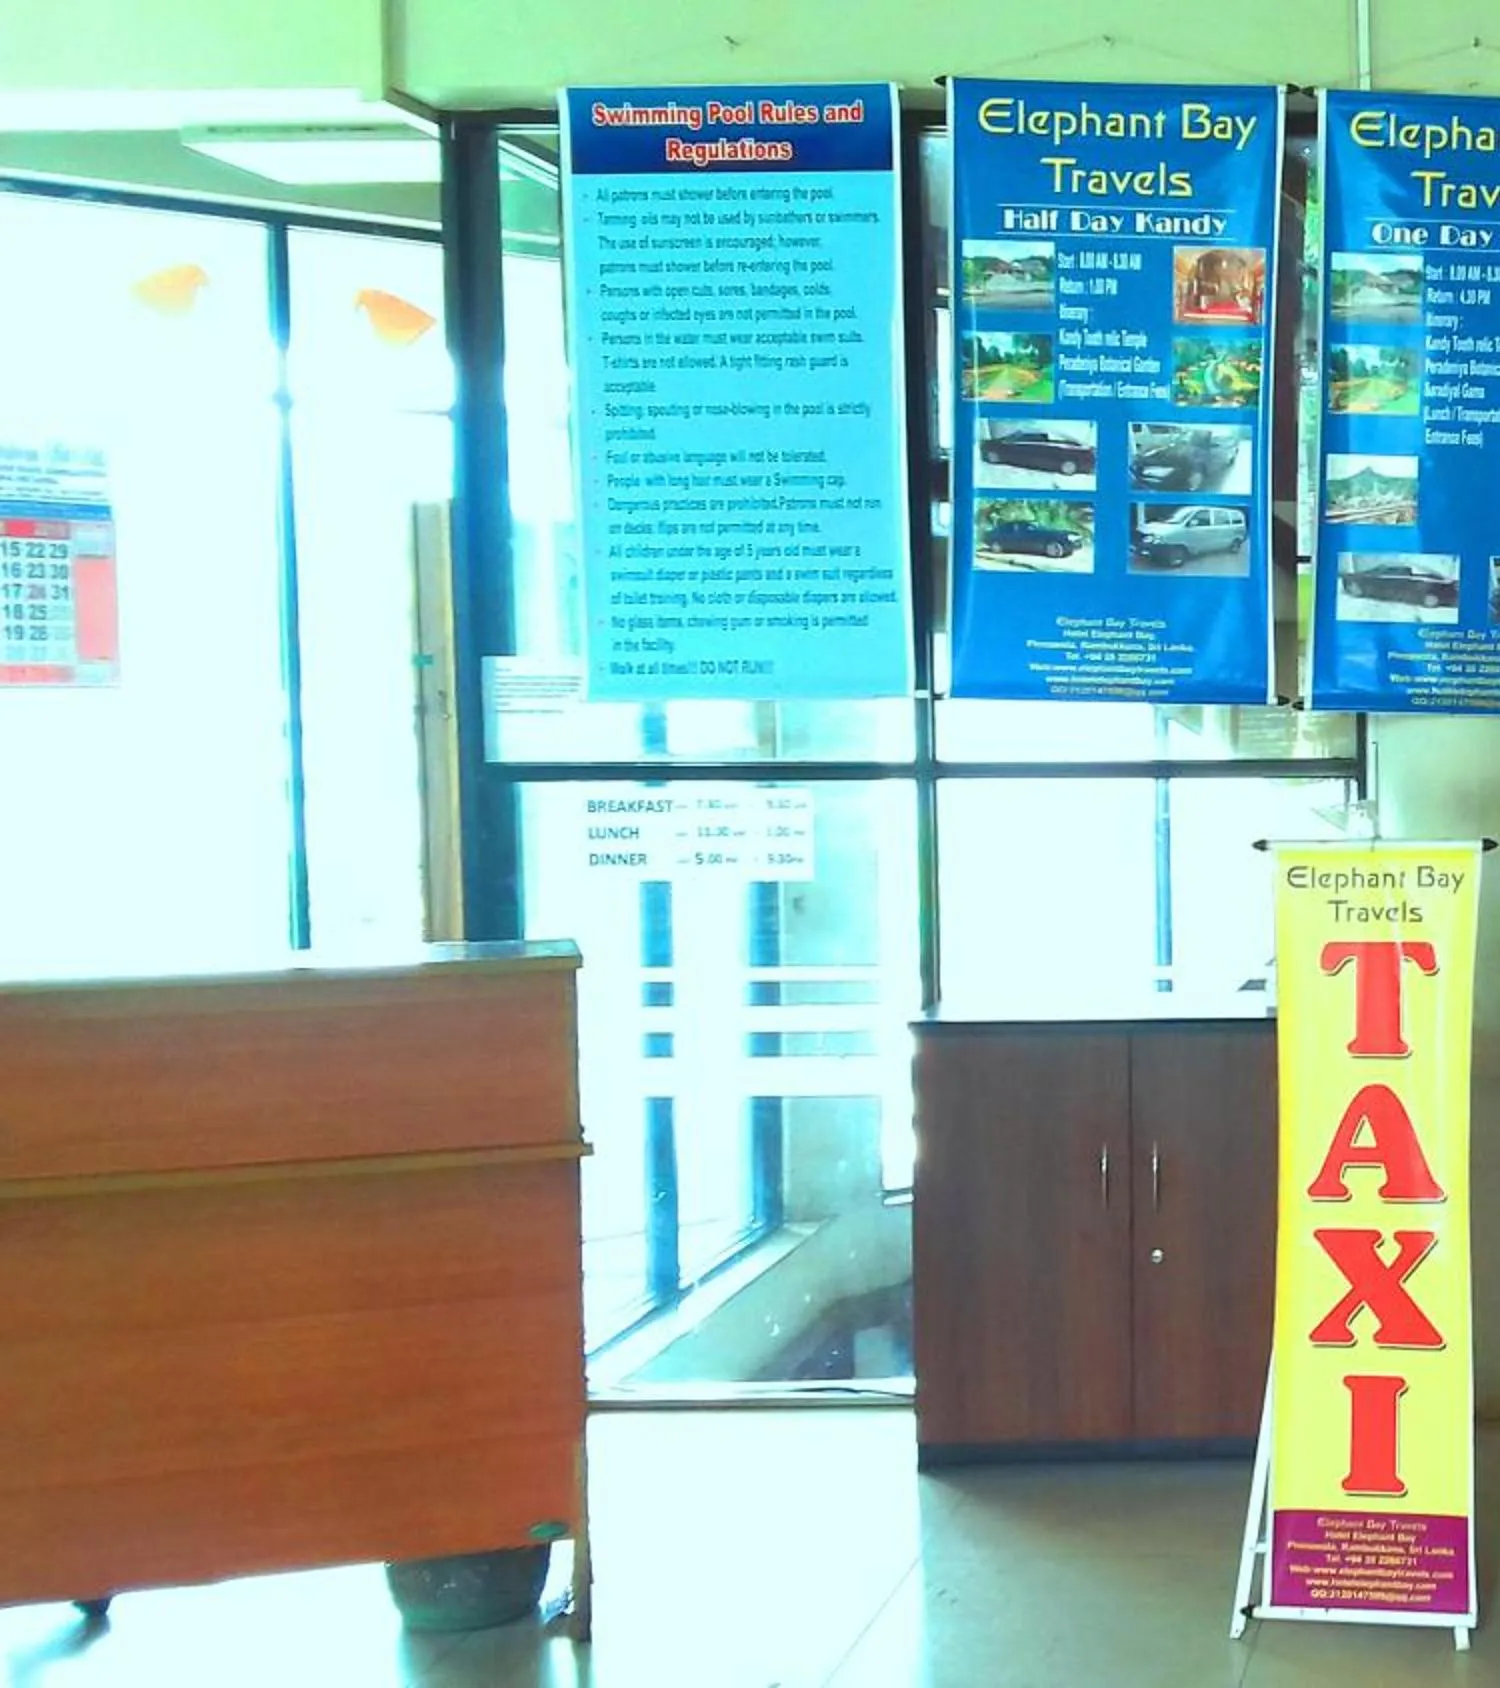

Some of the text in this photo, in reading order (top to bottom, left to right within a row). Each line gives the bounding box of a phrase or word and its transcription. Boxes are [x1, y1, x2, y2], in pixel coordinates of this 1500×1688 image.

[592, 99, 864, 130] Swimming Pool Rules and
[978, 97, 1257, 150] Elephant Bay
[665, 137, 793, 166] Regulations
[1040, 157, 1194, 197] Travels
[1003, 209, 1228, 236] Half Day Kandy
[1371, 223, 1429, 245] One
[1439, 225, 1494, 248] Day
[26, 542, 45, 559] 22
[50, 543, 69, 560] 29
[1, 562, 22, 579] 16
[27, 563, 46, 580] 23
[2, 584, 23, 600] 17
[51, 584, 70, 601] 31
[3, 604, 48, 621] 18 25
[4, 624, 25, 641] 19
[587, 799, 674, 813] BREAKFAST
[588, 827, 640, 840] LUNCH
[589, 853, 648, 867] DINNER
[1287, 865, 1465, 895] Elephant Bay
[1326, 900, 1424, 923] Travels
[1306, 940, 1448, 1497] TAXI
